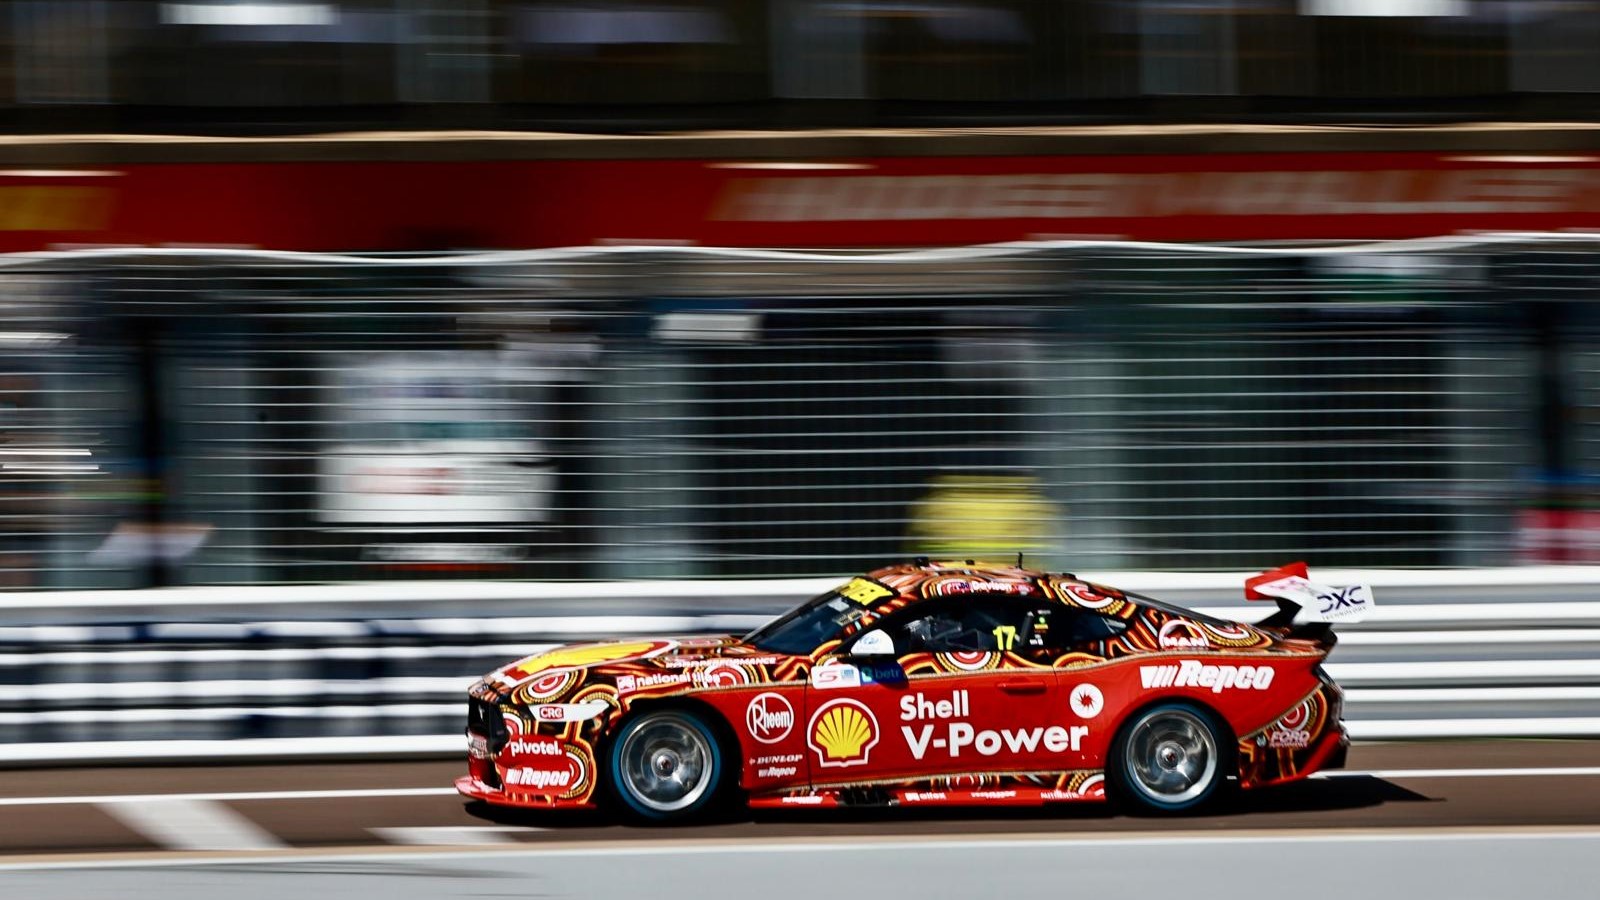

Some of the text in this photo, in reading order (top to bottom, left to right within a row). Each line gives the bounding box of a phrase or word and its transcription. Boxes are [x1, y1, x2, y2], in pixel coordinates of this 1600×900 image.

[1317, 586, 1365, 613] DXC
[992, 625, 1016, 651] 17
[1163, 637, 1206, 647] MAN
[636, 672, 690, 687] national
[1174, 660, 1275, 693] Repco
[752, 696, 792, 735] Rheem
[900, 690, 969, 721] Shell
[900, 722, 1089, 760] V-Power
[757, 754, 803, 765] DUNLOP
[768, 766, 797, 778] Repco
[520, 767, 571, 789] Repco
